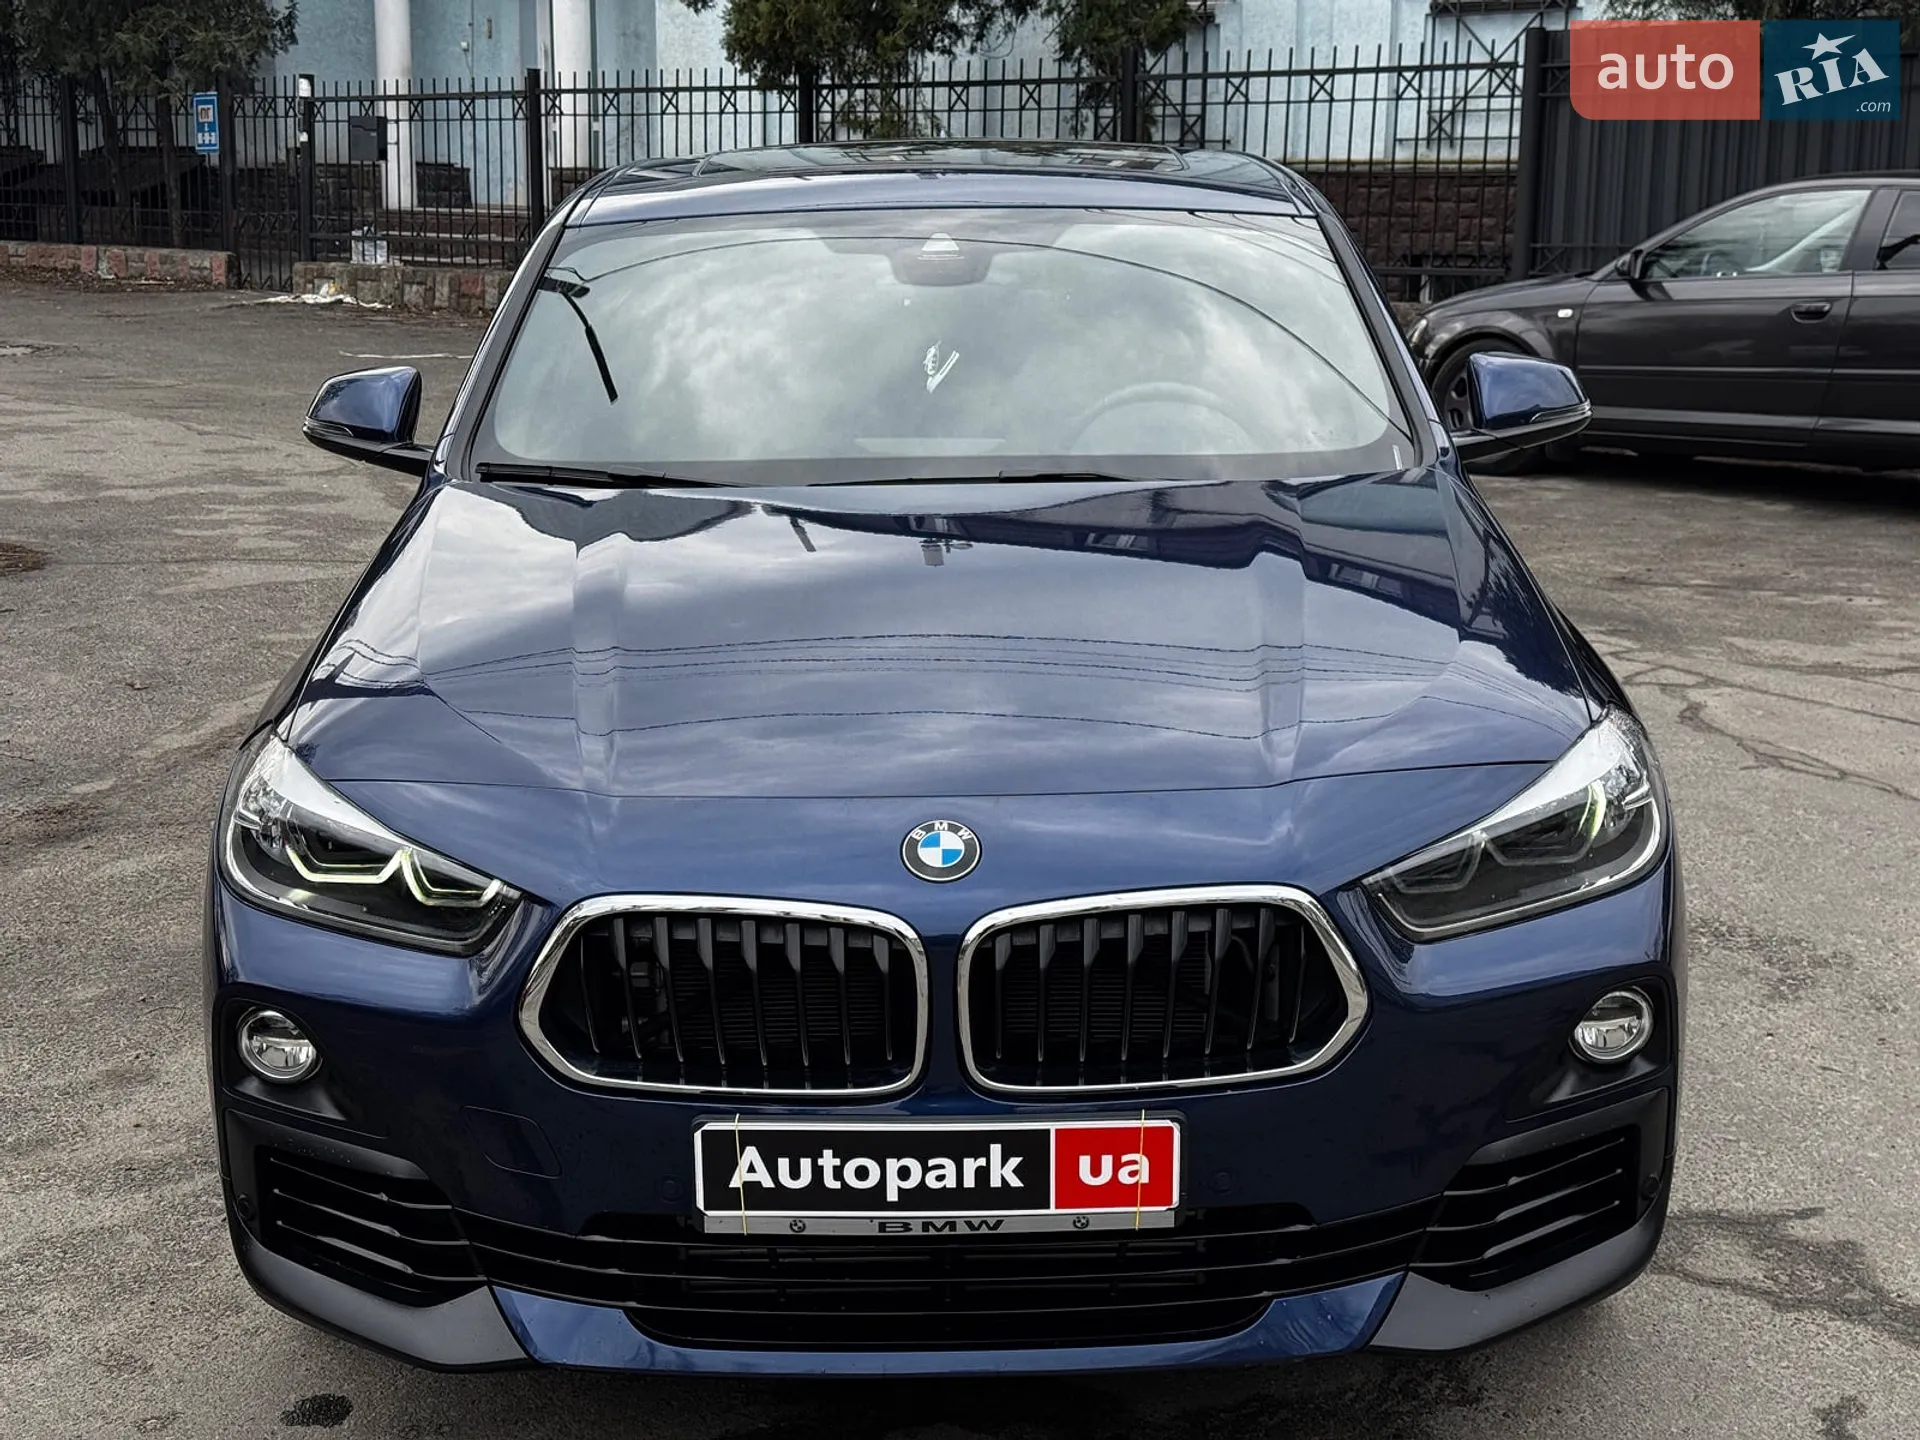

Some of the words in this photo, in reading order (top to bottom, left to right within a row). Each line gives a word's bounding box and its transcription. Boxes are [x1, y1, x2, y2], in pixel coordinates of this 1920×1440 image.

[911, 821, 973, 841] BMW
[728, 1144, 1024, 1202] Autopark
[1078, 1153, 1150, 1186] ua
[877, 1219, 1004, 1234] BMW
